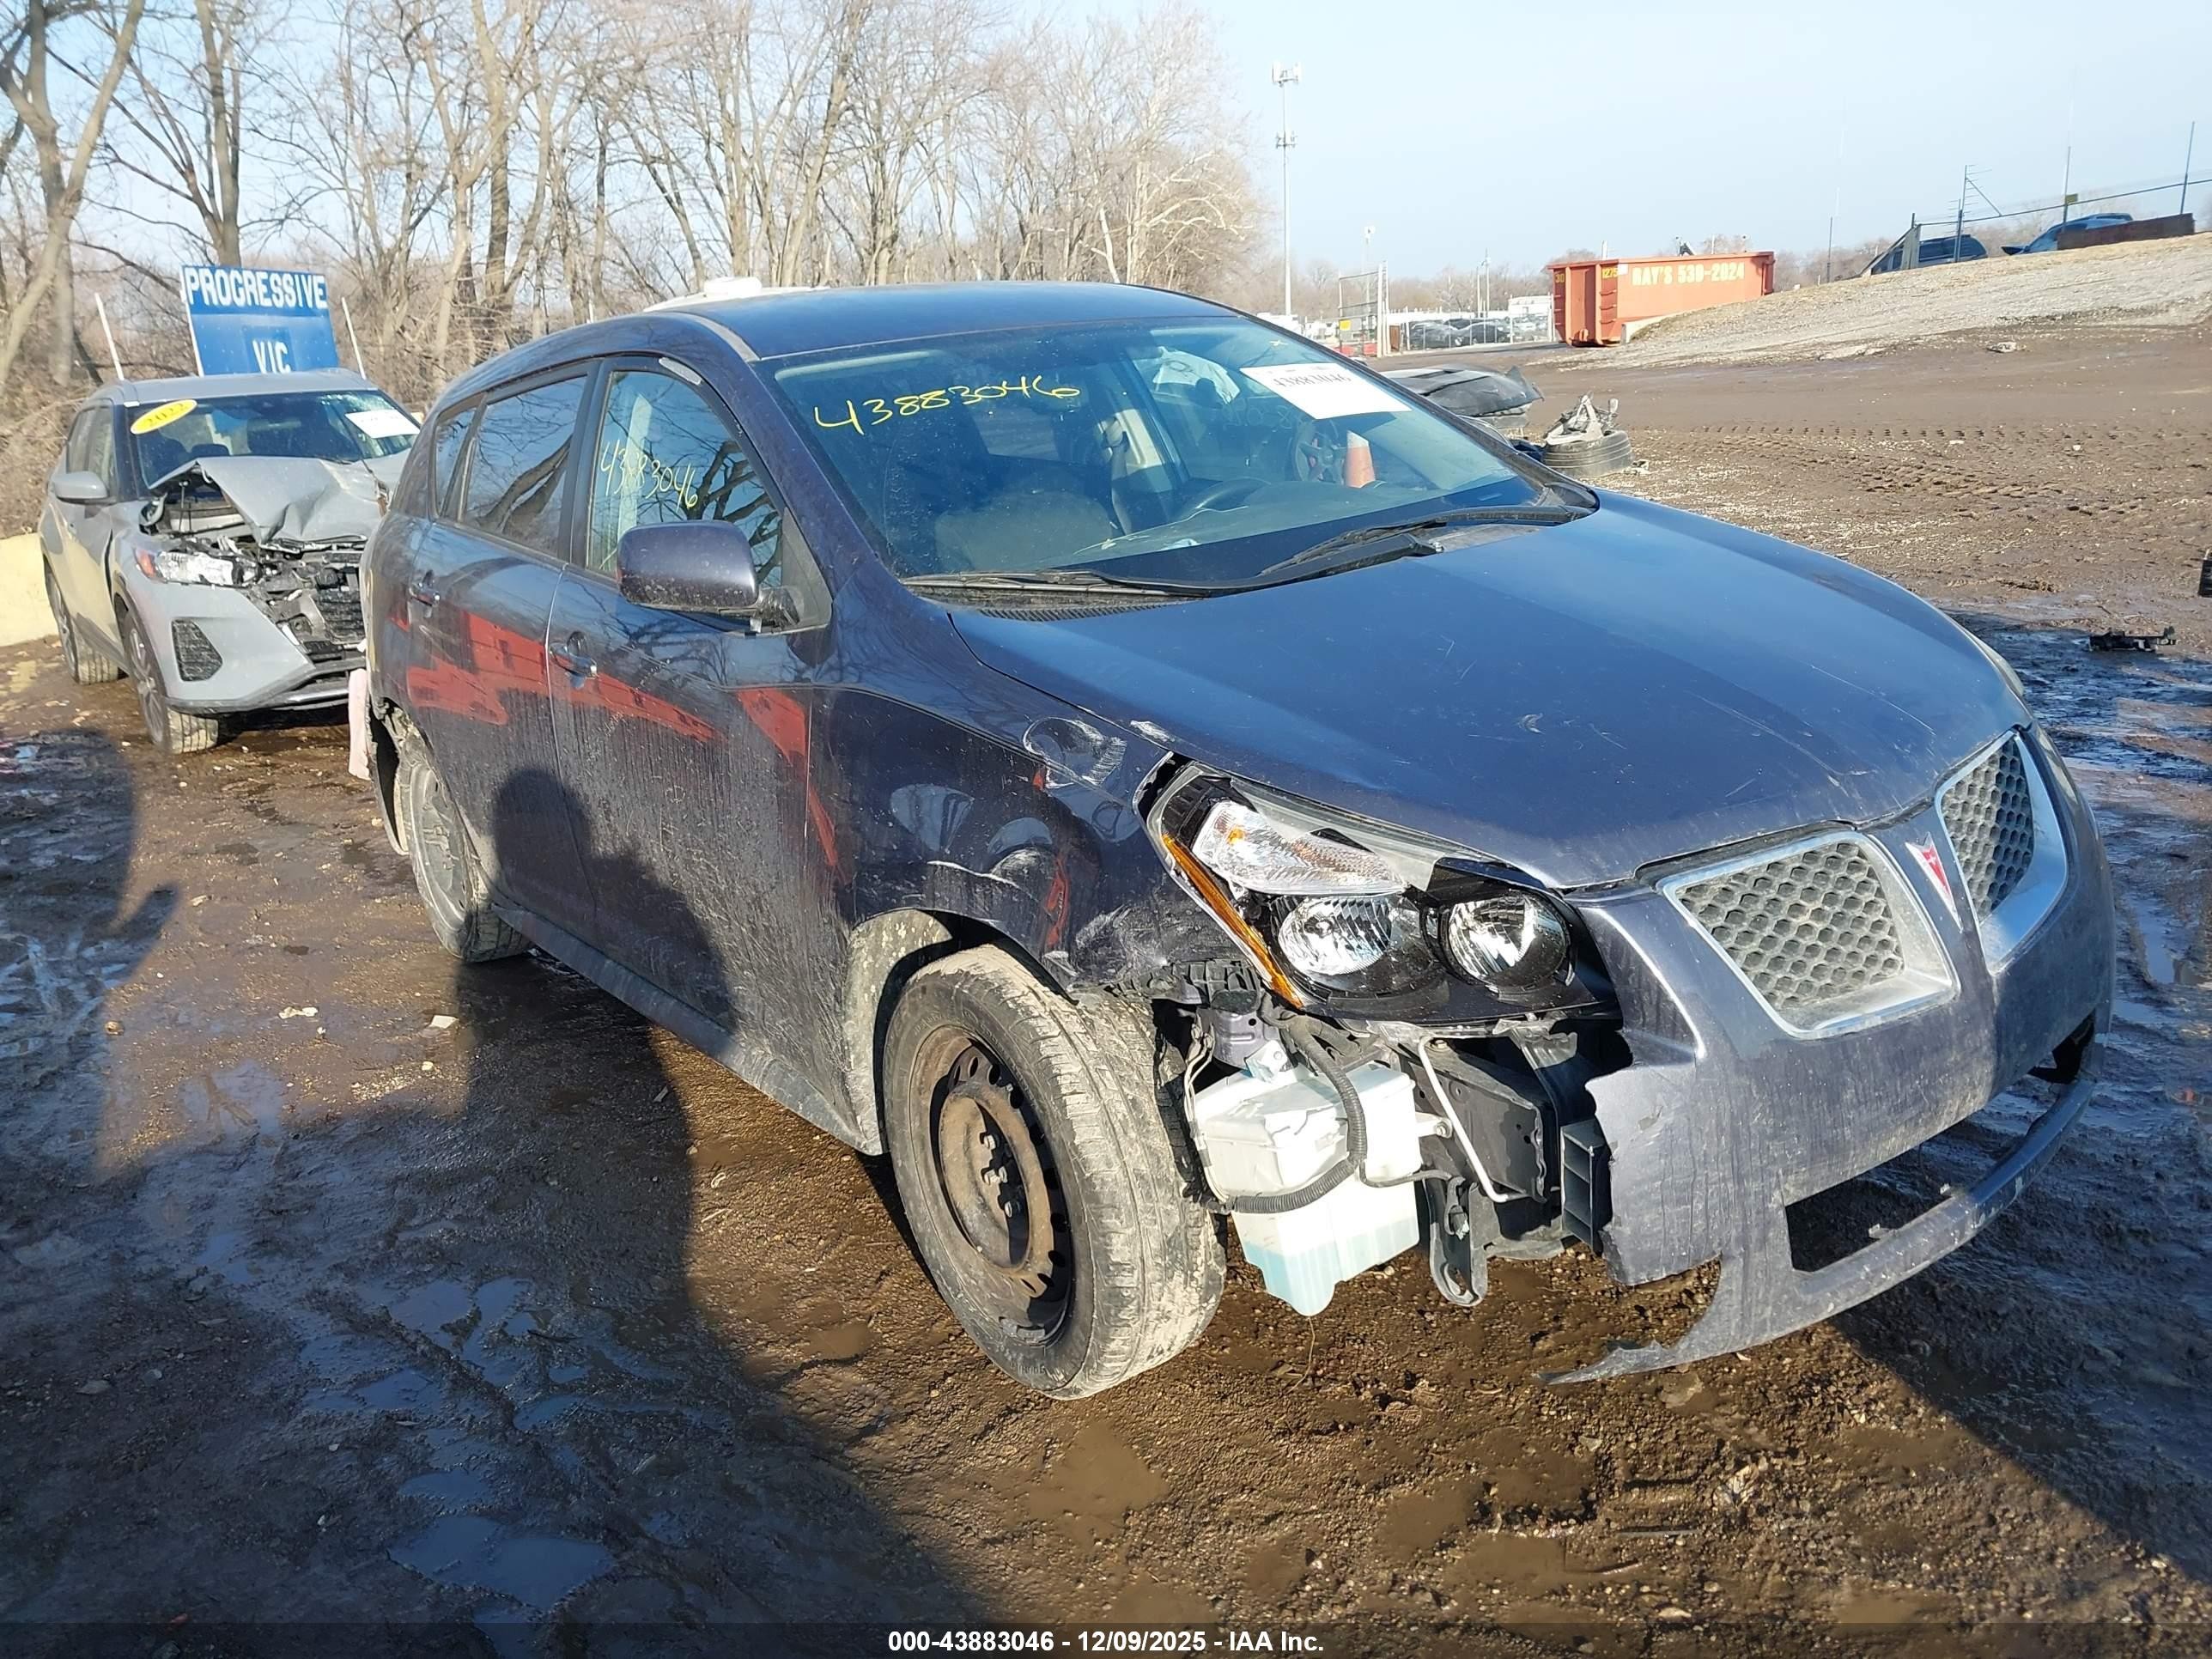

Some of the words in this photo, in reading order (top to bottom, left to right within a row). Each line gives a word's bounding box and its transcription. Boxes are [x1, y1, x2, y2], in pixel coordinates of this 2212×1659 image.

[185, 267, 328, 309] PROGRESSIVE
[1632, 266, 1673, 286] RAY'S
[252, 339, 291, 374] VIC
[814, 375, 1080, 435] 43883046
